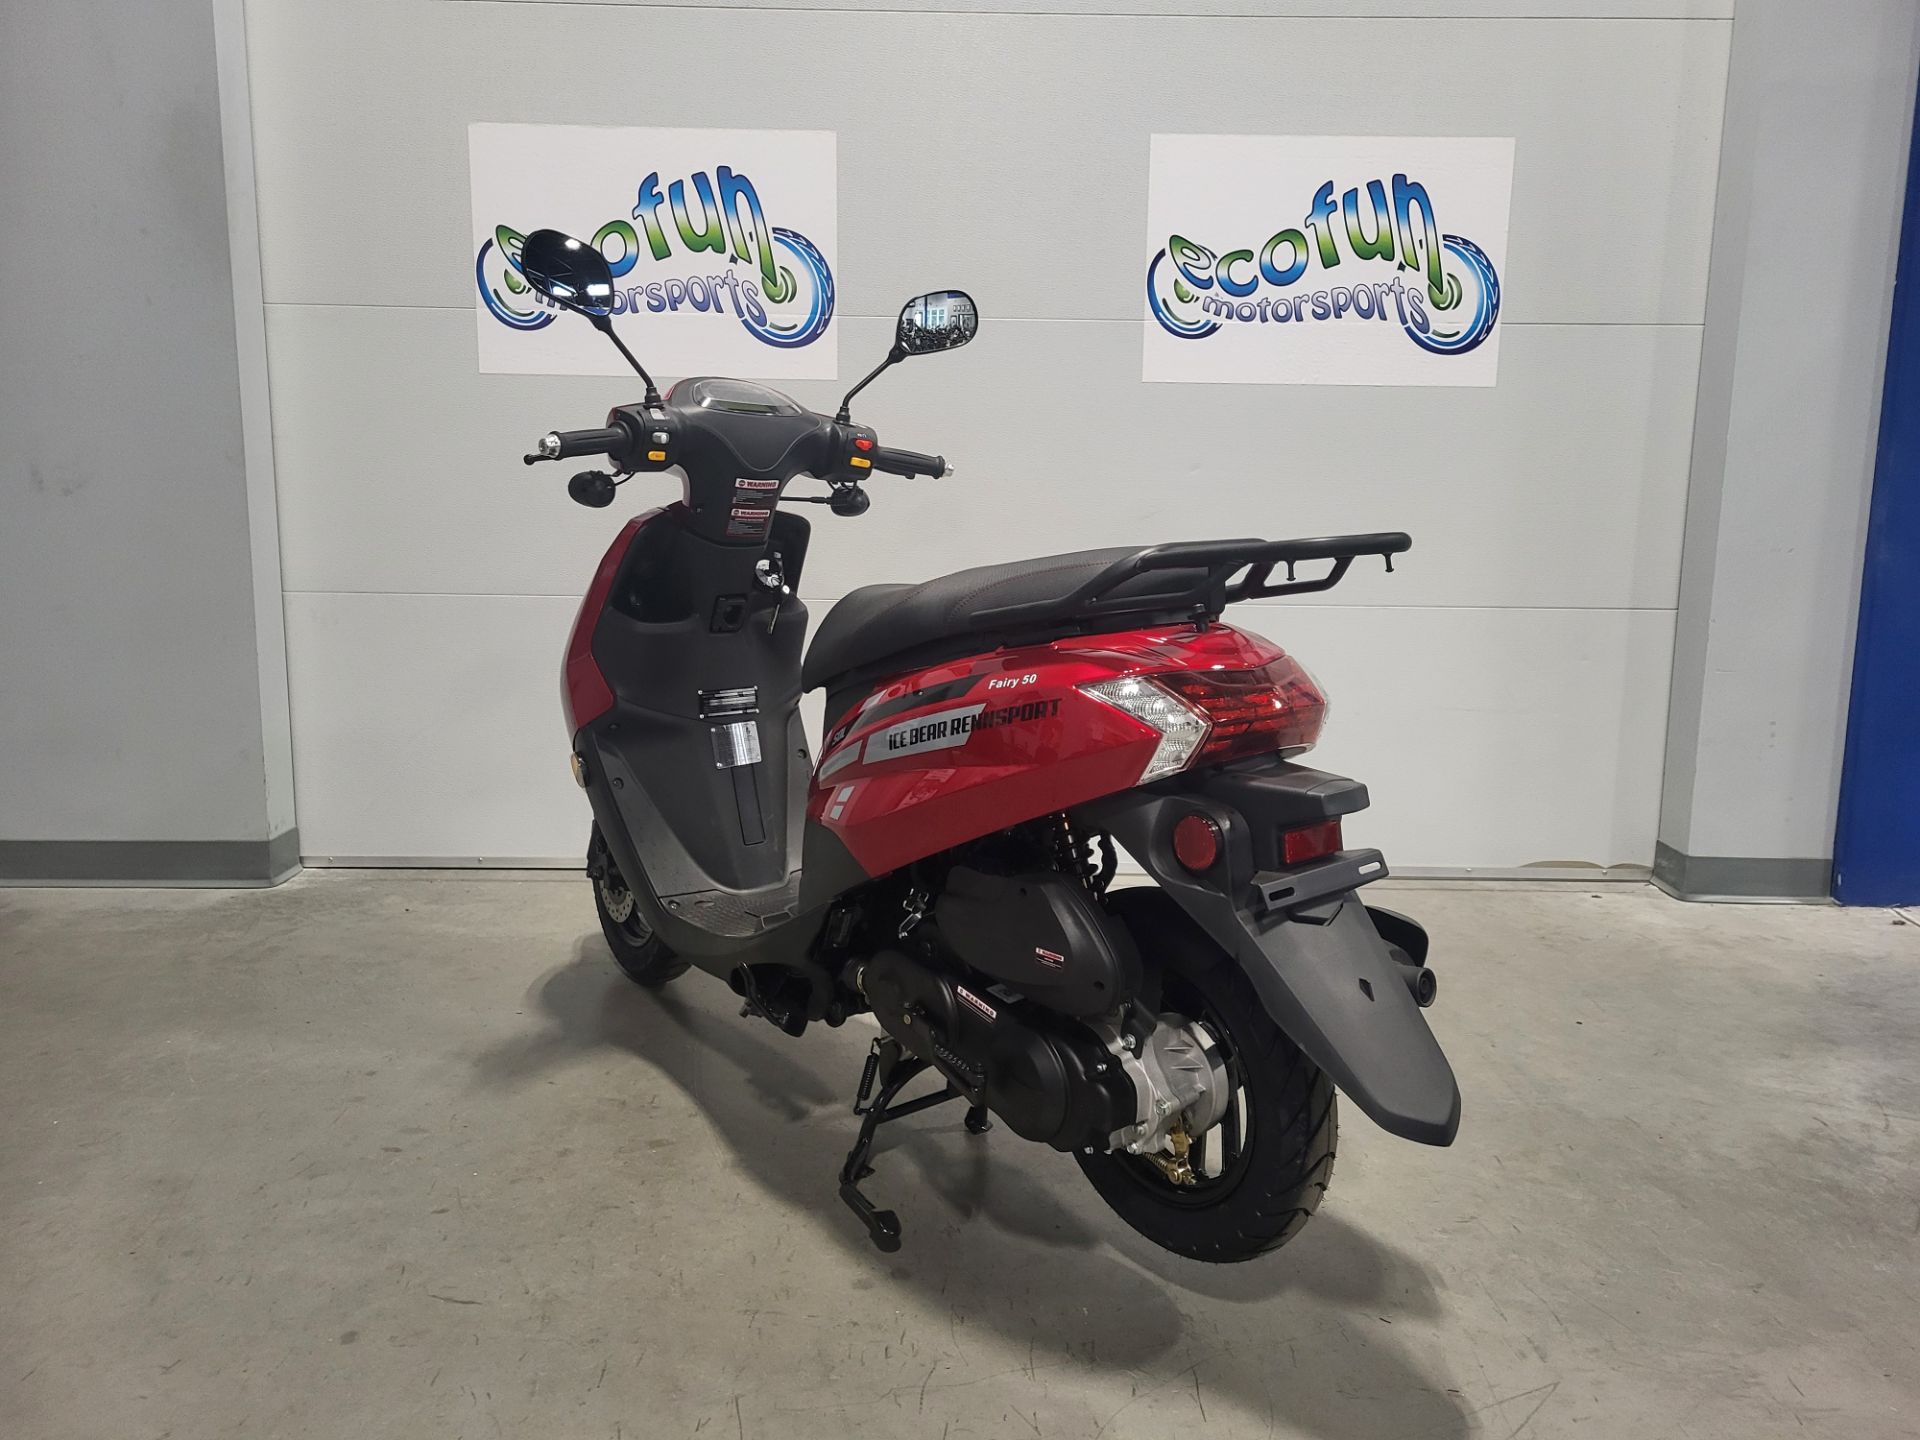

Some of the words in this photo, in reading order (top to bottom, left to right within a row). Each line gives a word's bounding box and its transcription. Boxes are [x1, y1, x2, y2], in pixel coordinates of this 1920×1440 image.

[496, 165, 778, 287] eofun
[1169, 173, 1443, 297] ecofun
[535, 269, 768, 328] orsports
[1202, 276, 1431, 335] motorsports
[988, 677, 1020, 690] Fairy
[1021, 673, 1038, 685] 50
[889, 730, 907, 750] ICE
[909, 721, 947, 745] BEAR
[950, 698, 1062, 736] RENNSPORT
